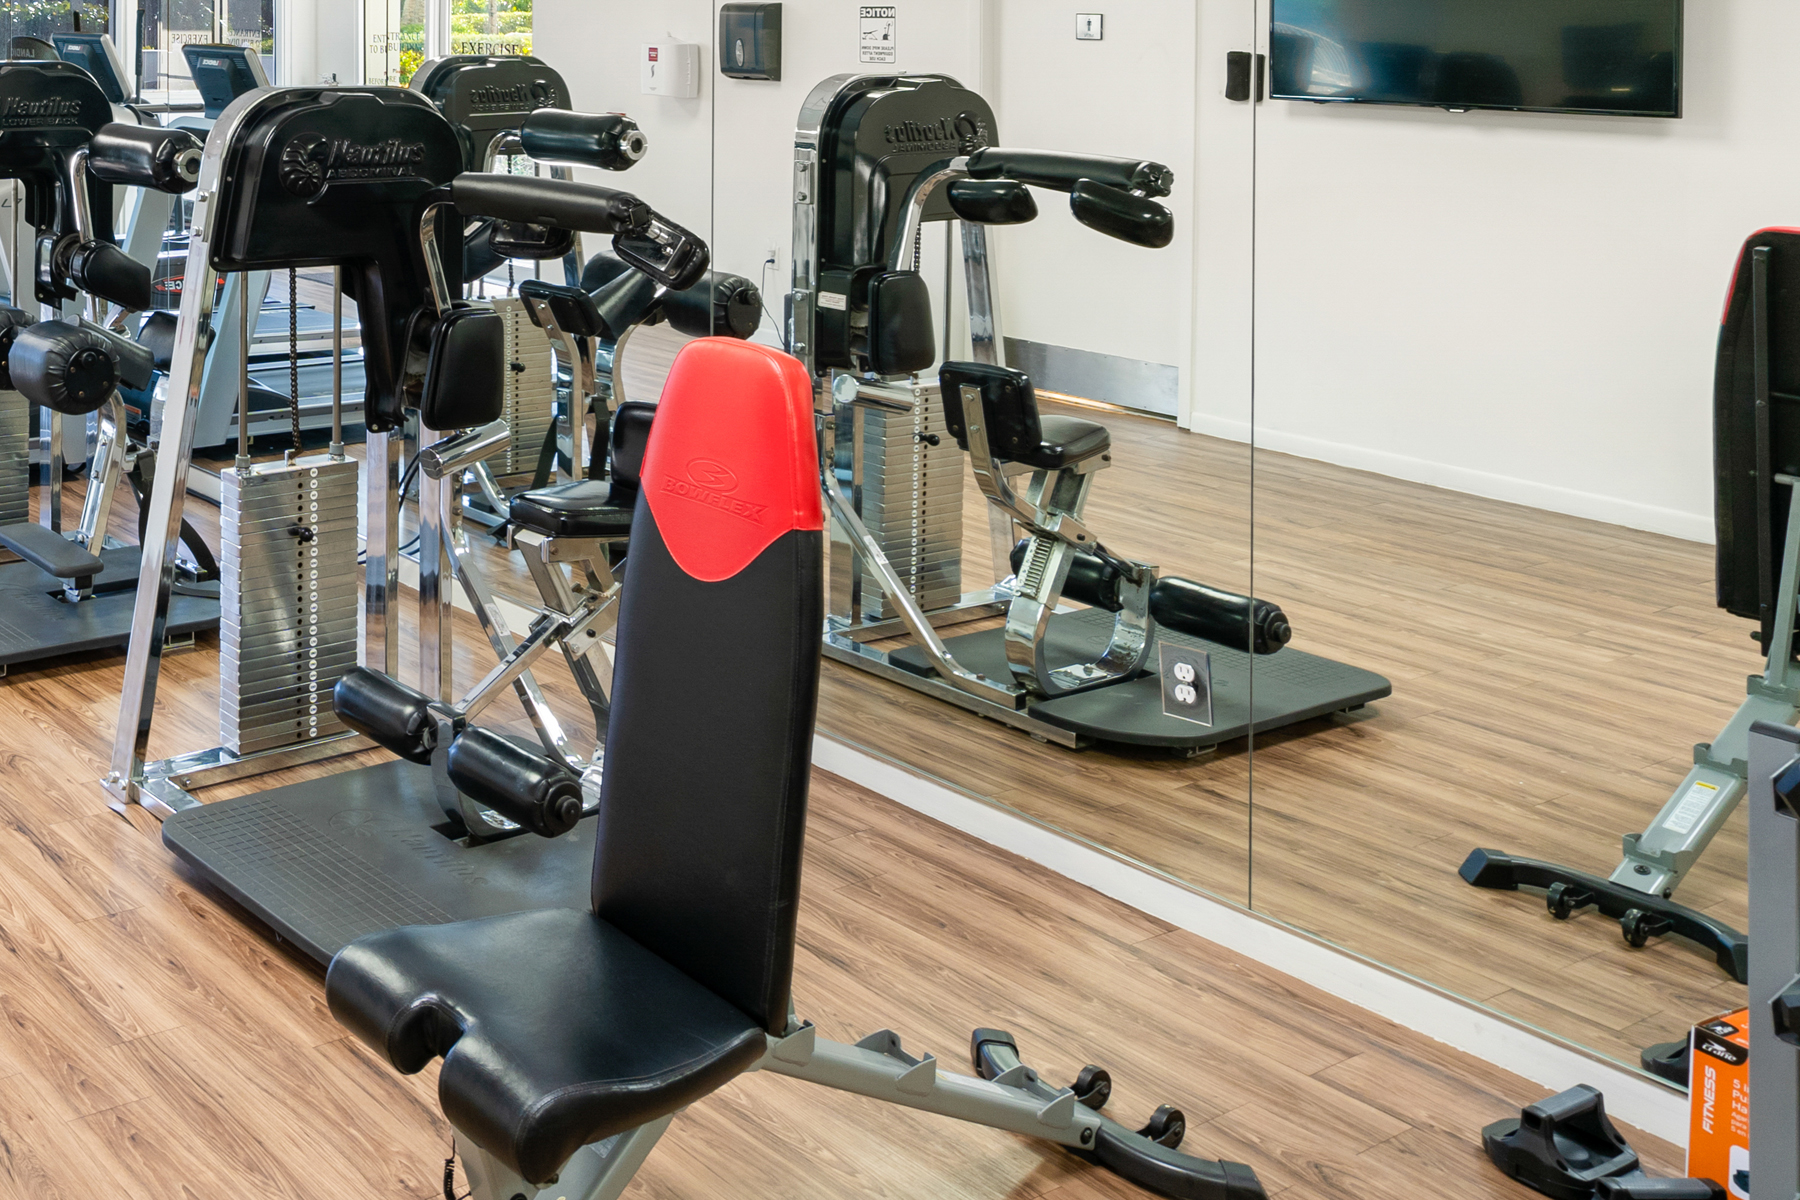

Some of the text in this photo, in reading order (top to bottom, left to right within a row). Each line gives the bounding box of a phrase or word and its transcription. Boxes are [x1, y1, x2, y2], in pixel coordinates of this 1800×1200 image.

[461, 41, 519, 55] EXERCISE
[2, 96, 82, 118] Nautilus
[2, 116, 79, 126] LOWER BACK
[327, 138, 426, 166] Nautilus
[325, 166, 416, 179] ABDOMINAL
[663, 477, 762, 521] BOWFLEX
[1702, 1042, 1738, 1062] crane
[1733, 1078, 1741, 1089] 5
[1702, 1064, 1717, 1135] FITNESS
